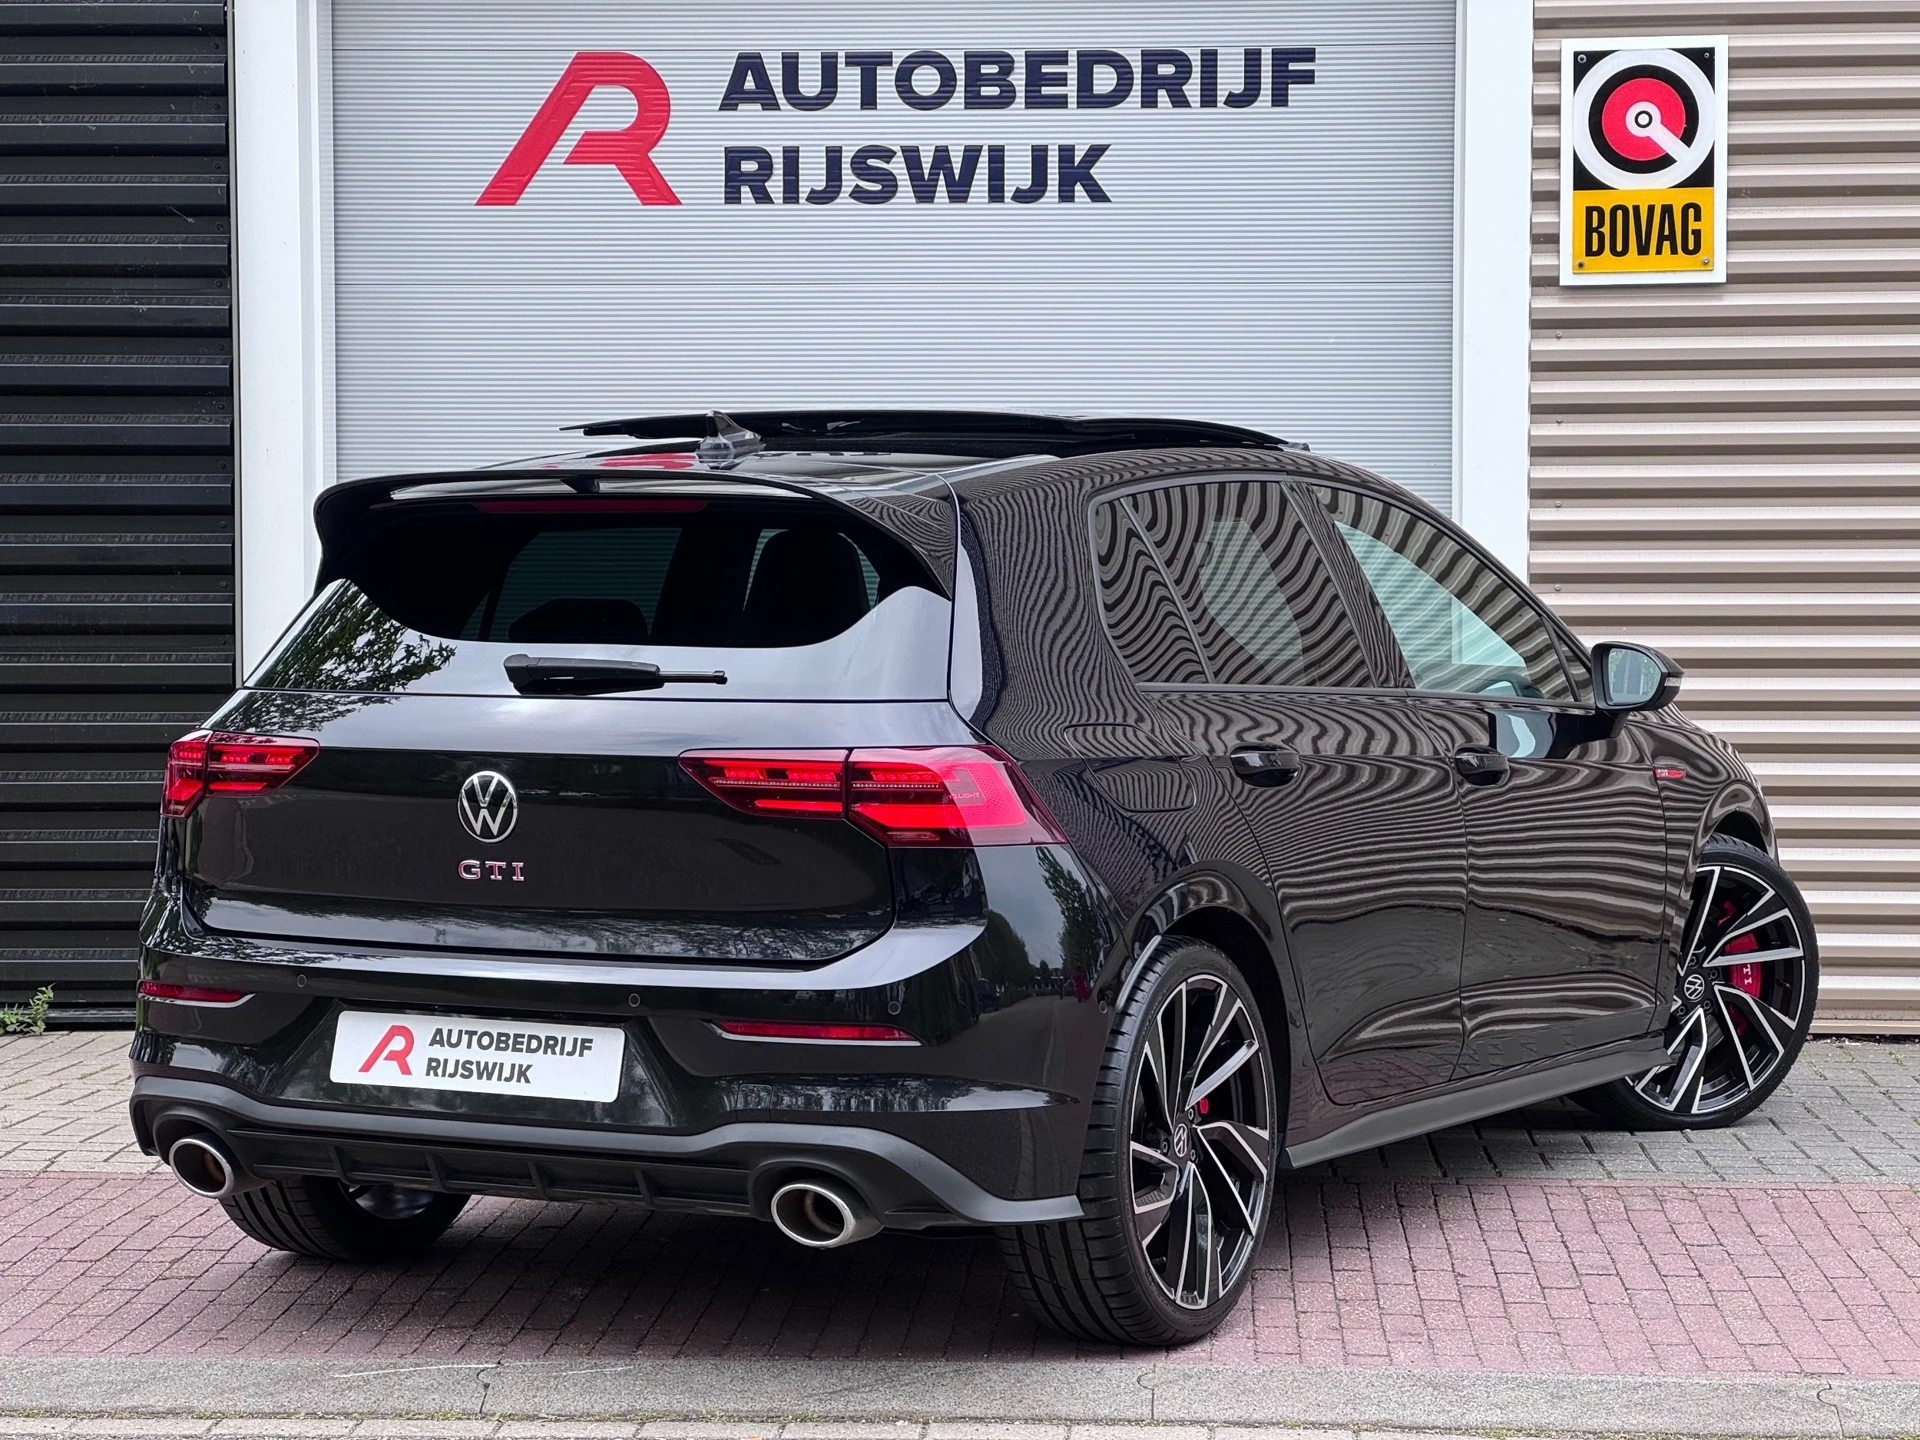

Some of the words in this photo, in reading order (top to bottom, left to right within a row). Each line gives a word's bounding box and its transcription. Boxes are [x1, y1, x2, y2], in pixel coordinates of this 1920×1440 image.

[719, 48, 1317, 110] AUTOBEDRIJF
[725, 144, 1112, 204] RIJSWIJK
[1585, 203, 1702, 257] BOVAG
[458, 859, 525, 882] GTI
[428, 1027, 594, 1058] AUTOBEDRIJF
[425, 1057, 533, 1084] RIJSWIJK
